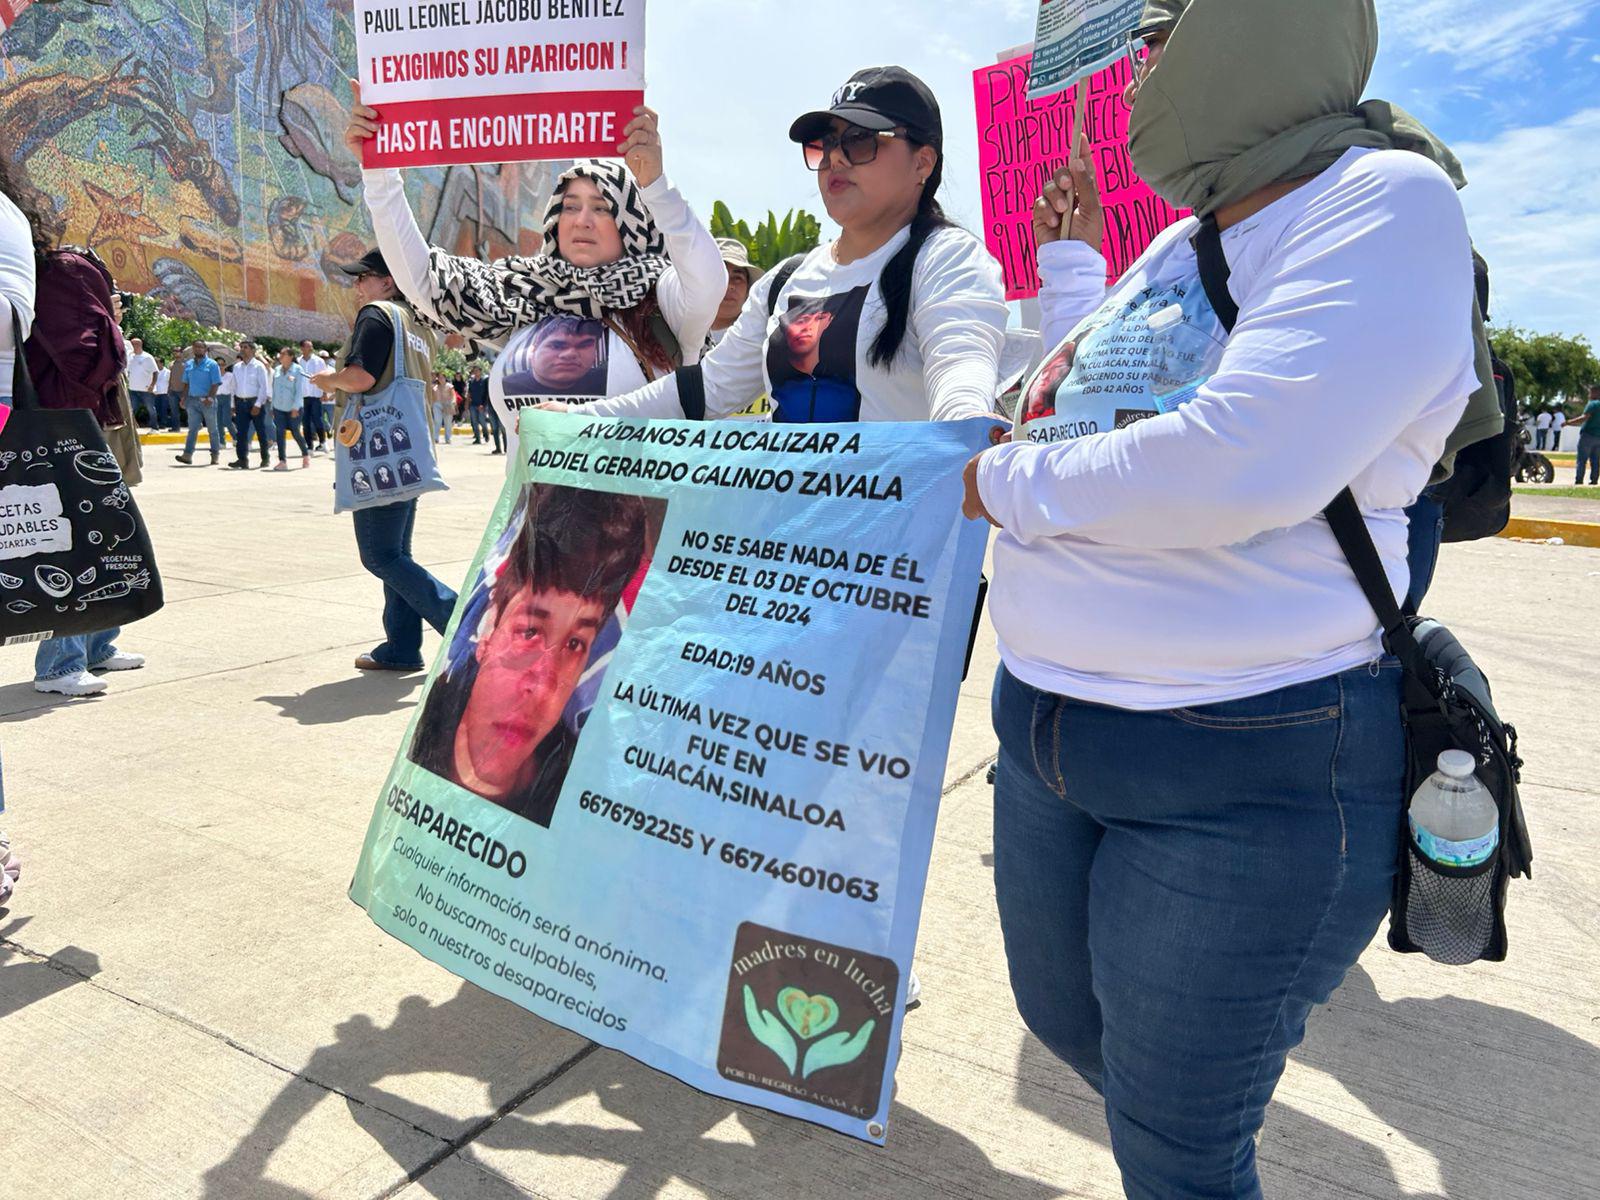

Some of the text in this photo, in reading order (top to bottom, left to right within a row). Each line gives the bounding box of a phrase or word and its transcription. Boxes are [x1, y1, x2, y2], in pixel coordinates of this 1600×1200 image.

[364, 3, 404, 34] PAUL
[409, 0, 470, 30] LEONEL
[476, 0, 541, 24] JACOBO
[382, 49, 470, 83] EXIGIMOS
[474, 46, 499, 76] SU
[505, 41, 615, 75] APARICION
[831, 81, 866, 106] NY
[376, 111, 617, 154] HASTA ENCONTRARTE
[1110, 347, 1127, 355] VEZ
[1128, 347, 1149, 357] QUE
[1174, 352, 1197, 363] FUE
[1126, 371, 1140, 380] SU
[1082, 383, 1144, 395] EDAD 42 AÑOS
[54, 443, 85, 454] DE AVENA
[57, 438, 78, 446] PLATO
[579, 420, 861, 454] AYÚDANOS A LOCALIZAR A
[527, 448, 903, 502] ADDIEL GERARDO GALINDO ZAVALA
[100, 555, 142, 563] VEGETALES
[105, 563, 138, 571] FRESCOS
[681, 529, 925, 583] NO SE SABE NADA DE ÉL
[667, 555, 930, 619] DESDE EL 03 DE OCTUBRE
[725, 593, 812, 627] DEL 2024
[680, 641, 827, 697] EDAD:19 AÑOS
[612, 681, 912, 780] LA ÚLTIMA VEZ QUE SE VIO
[686, 735, 767, 778] FUE EN
[386, 784, 528, 878] DESAPARECIDO
[579, 790, 880, 903] 6676792255 Y 6674601063
[393, 836, 669, 984] Cualquier información será anónima.
[415, 882, 598, 991] No buscamos culpables,
[392, 903, 628, 1033] solo a nuestros desaparecidos
[733, 940, 892, 1017] madres en lucha
